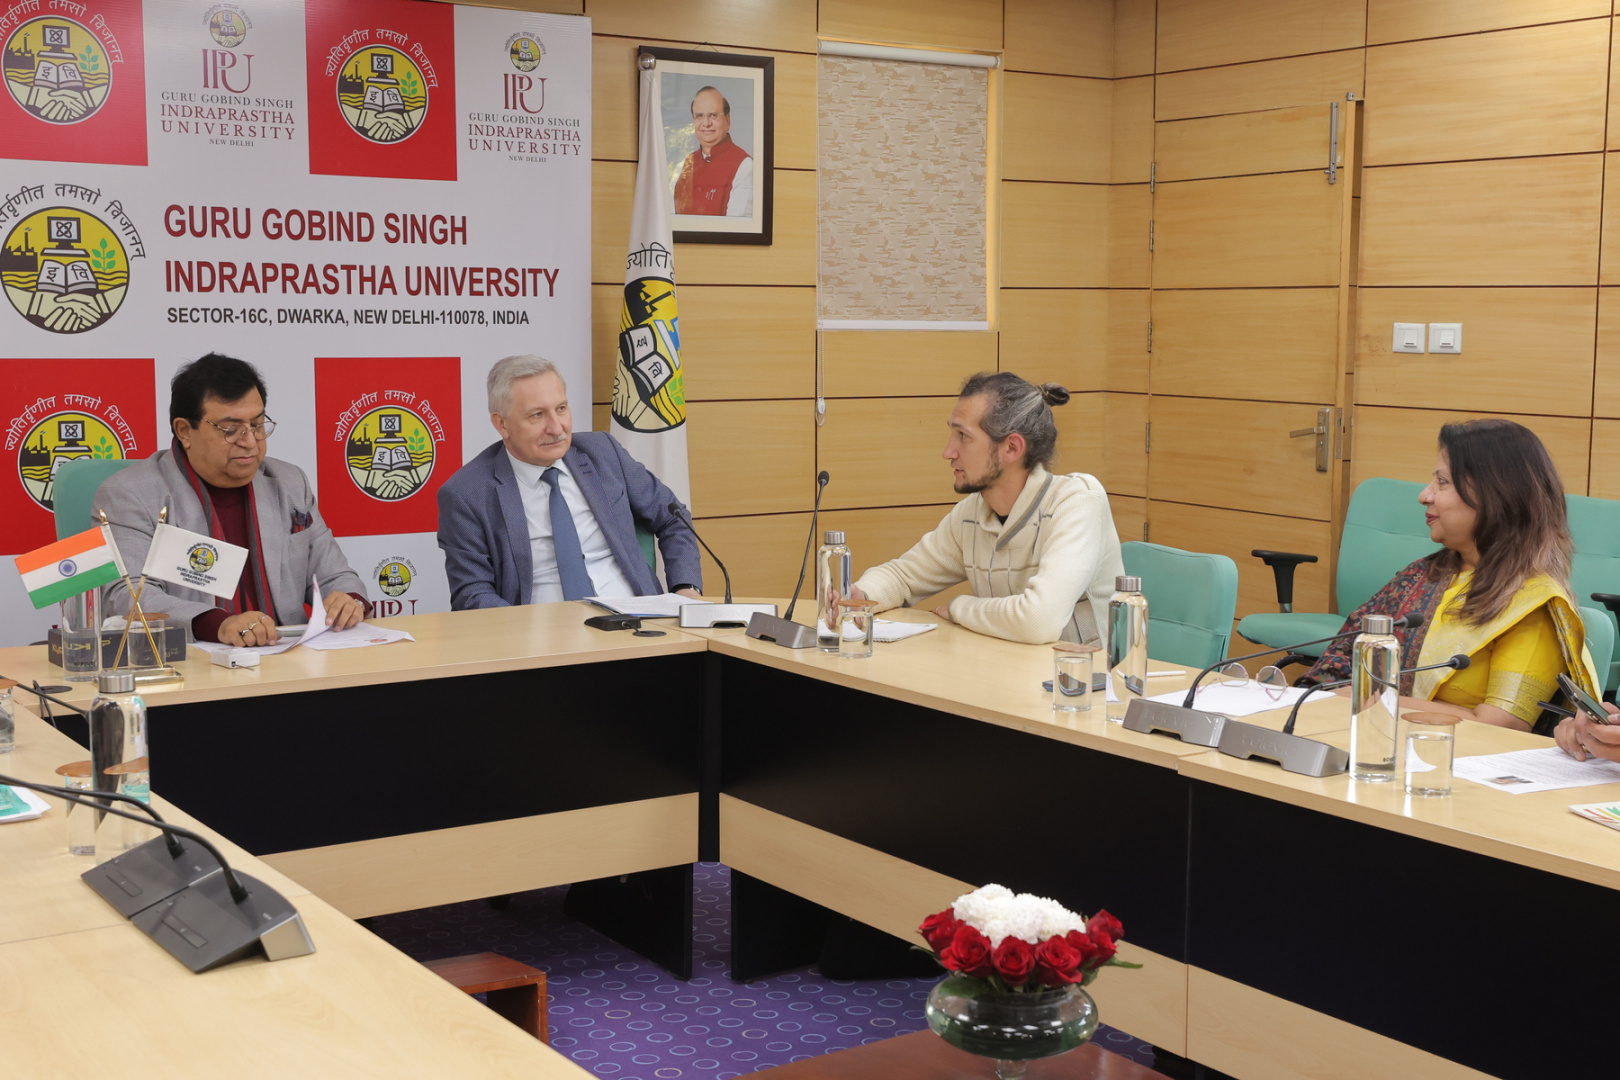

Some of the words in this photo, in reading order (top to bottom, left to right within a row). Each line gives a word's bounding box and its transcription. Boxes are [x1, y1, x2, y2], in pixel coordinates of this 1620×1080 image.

[376, 28, 408, 46] तमसो
[161, 91, 196, 102] GURU
[201, 93, 251, 106] GOBIND
[255, 97, 293, 108] SINGH
[161, 104, 295, 124] INDRAPRASTHA
[469, 112, 498, 122] GURU
[502, 114, 544, 125] GOBIND
[547, 117, 580, 127] SINGH
[161, 120, 295, 140] UNIVERSITY
[468, 124, 581, 141] INDRAPRASTHA
[230, 139, 254, 147] DELHI
[469, 138, 581, 155] UNIVERSITY
[526, 155, 547, 163] DELHI
[54, 183, 101, 205] तमसो
[164, 204, 251, 239] GURU
[261, 208, 375, 243] GOBIND
[383, 212, 467, 245] SINGH
[165, 260, 398, 296] INDRAPRASTHA
[405, 265, 560, 297] UNIVERSITY
[167, 307, 273, 326] SECTOR-16C,
[277, 308, 349, 326] DWARKA,
[353, 309, 388, 324] NEW
[391, 309, 489, 327] DELHI-110078,
[492, 310, 530, 325] INDIA
[64, 394, 102, 410] तमसो
[384, 389, 416, 405] तमसो
